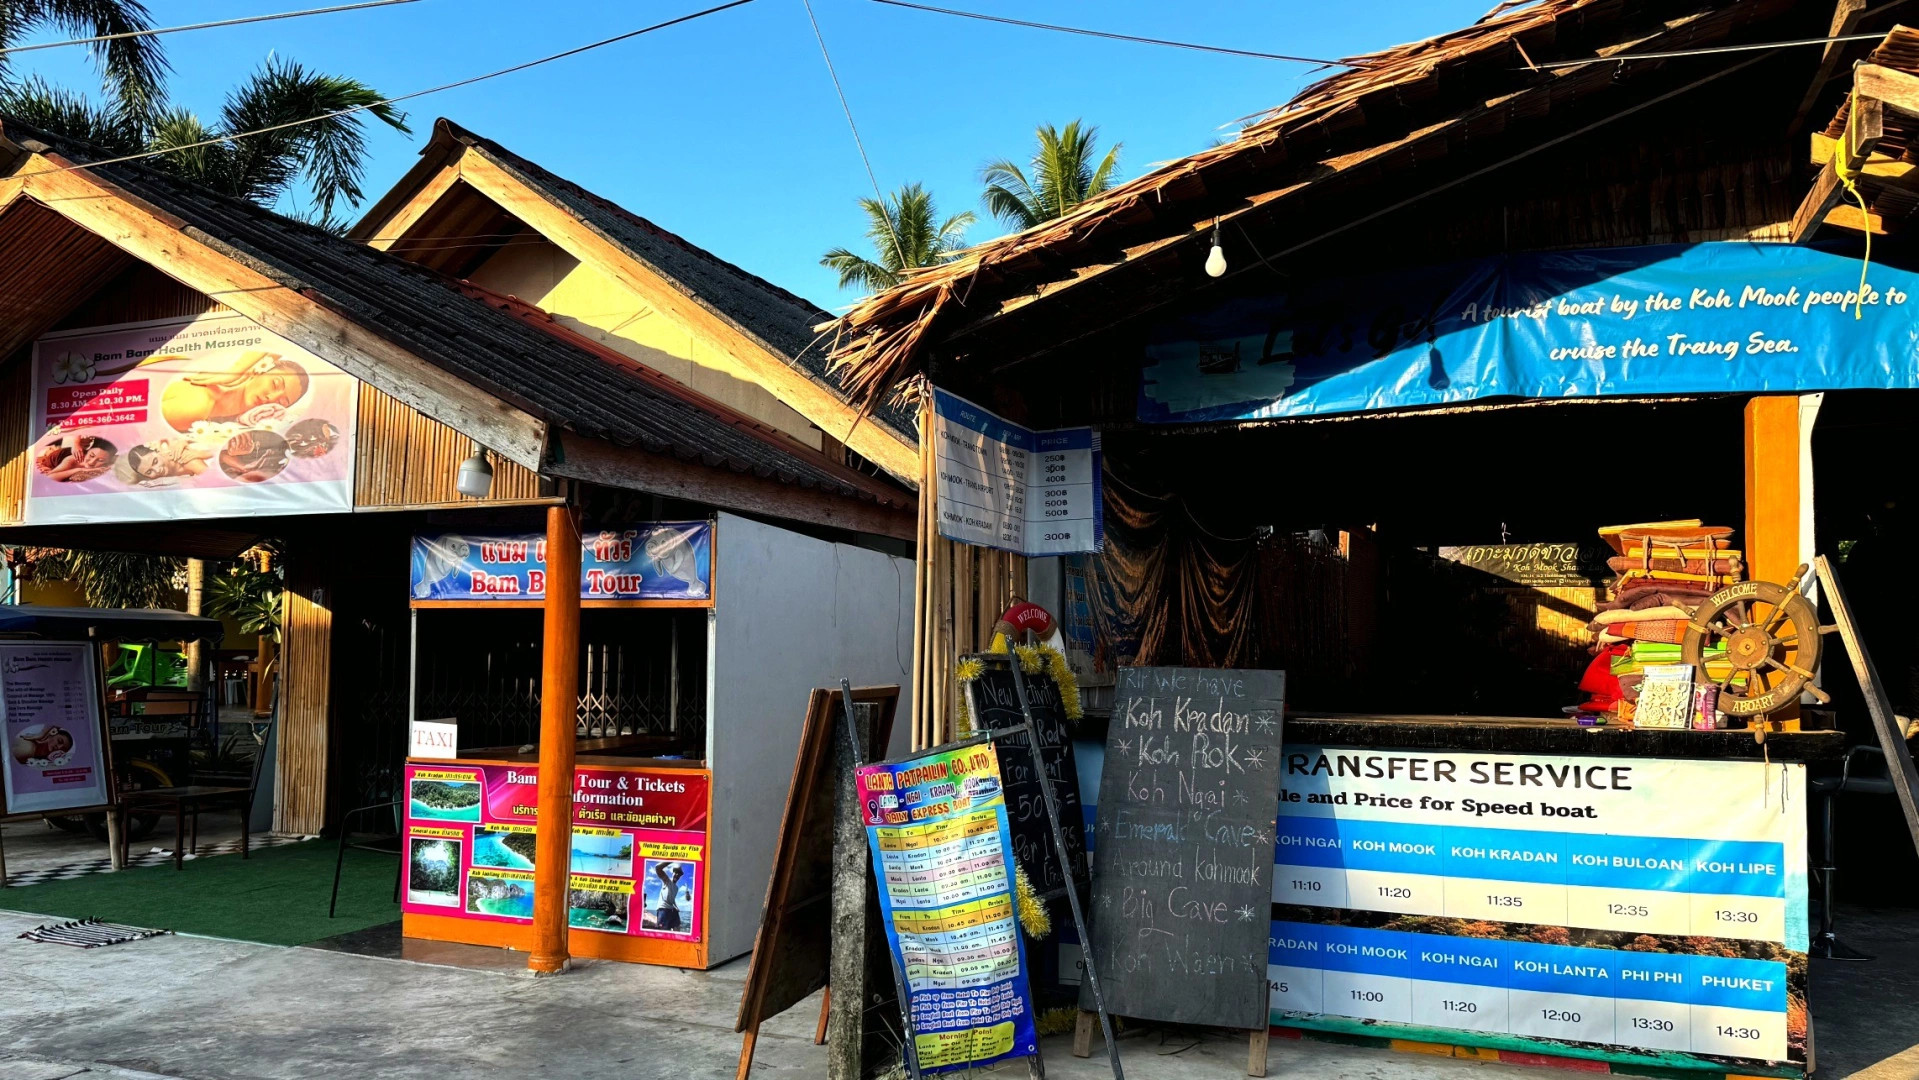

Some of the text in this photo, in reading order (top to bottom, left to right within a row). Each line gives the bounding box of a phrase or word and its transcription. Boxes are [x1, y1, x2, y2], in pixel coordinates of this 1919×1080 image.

[1461, 284, 1908, 322] A tourist boat by the Koh Mook people to
[94, 336, 262, 361] Bam Bam Health Massage
[1550, 331, 1799, 361] cruise the Trang Sea.
[72, 387, 123, 398] Open Daily
[99, 396, 123, 405] 10.30
[126, 394, 144, 403] PM.
[1041, 437, 1068, 446] PRICE
[481, 541, 527, 562] แบม
[594, 531, 637, 562] ทัวร์
[1513, 563, 1530, 572] Koh
[1534, 562, 1560, 572] Mook
[471, 570, 519, 594] Bam
[587, 569, 642, 594] Tour
[1710, 583, 1758, 607] WELCOME
[1018, 608, 1048, 624] WELCOME
[981, 677, 1058, 710] New ctivity
[1154, 669, 1186, 692] We
[1197, 671, 1245, 697] have
[1125, 696, 1162, 730] Koh
[134, 722, 167, 734] Tour
[414, 730, 453, 748] TAXI
[1036, 719, 1060, 747] Rod
[1139, 733, 1246, 774] Koh Rok
[507, 771, 685, 793] Bam Tour & Tickets
[865, 772, 894, 790] LANTA
[896, 762, 948, 789] PATPAILIN
[1006, 758, 1028, 782] For
[1288, 753, 1632, 791] RANSFER SERVICE
[905, 792, 922, 805] NGAI
[930, 782, 956, 798] KRADAN
[1128, 770, 1225, 815] Koh Ngai
[1307, 791, 1348, 805] and
[1354, 792, 1413, 808] Price
[1419, 796, 1455, 811] for
[1462, 799, 1533, 817] Speed
[1541, 802, 1598, 819] boat
[886, 797, 971, 823] DAILY EXPRESS BOAT
[1018, 794, 1043, 822] 50
[1205, 810, 1255, 847] Cave
[1015, 834, 1037, 863] Per
[1306, 837, 1342, 849] NGAI
[1353, 840, 1386, 852] KOH
[1389, 843, 1436, 856] MOOK
[1452, 846, 1486, 859] KOH
[1489, 849, 1558, 863] KRADAN
[1572, 854, 1609, 867] KOH
[1612, 856, 1683, 871] BULOAN
[1696, 860, 1735, 874] KOH
[1738, 862, 1776, 876] LIPE
[1112, 848, 1182, 880] Around
[1123, 886, 1228, 936] Big Cave
[1291, 880, 1758, 923] 11:10 11:20 11:35 12:35 13:30
[1269, 937, 1774, 992] RADAN KOH MOOK KOH NGAI KOH LANTA PHI PHI PHUKET
[1350, 990, 1384, 1002] 11:00
[1442, 1000, 1477, 1013] 11:20
[1542, 1010, 1581, 1023] 12:00
[1632, 1018, 1674, 1032] 13:30
[1716, 1026, 1760, 1040] 14:30
[939, 1032, 968, 1041] Morning
